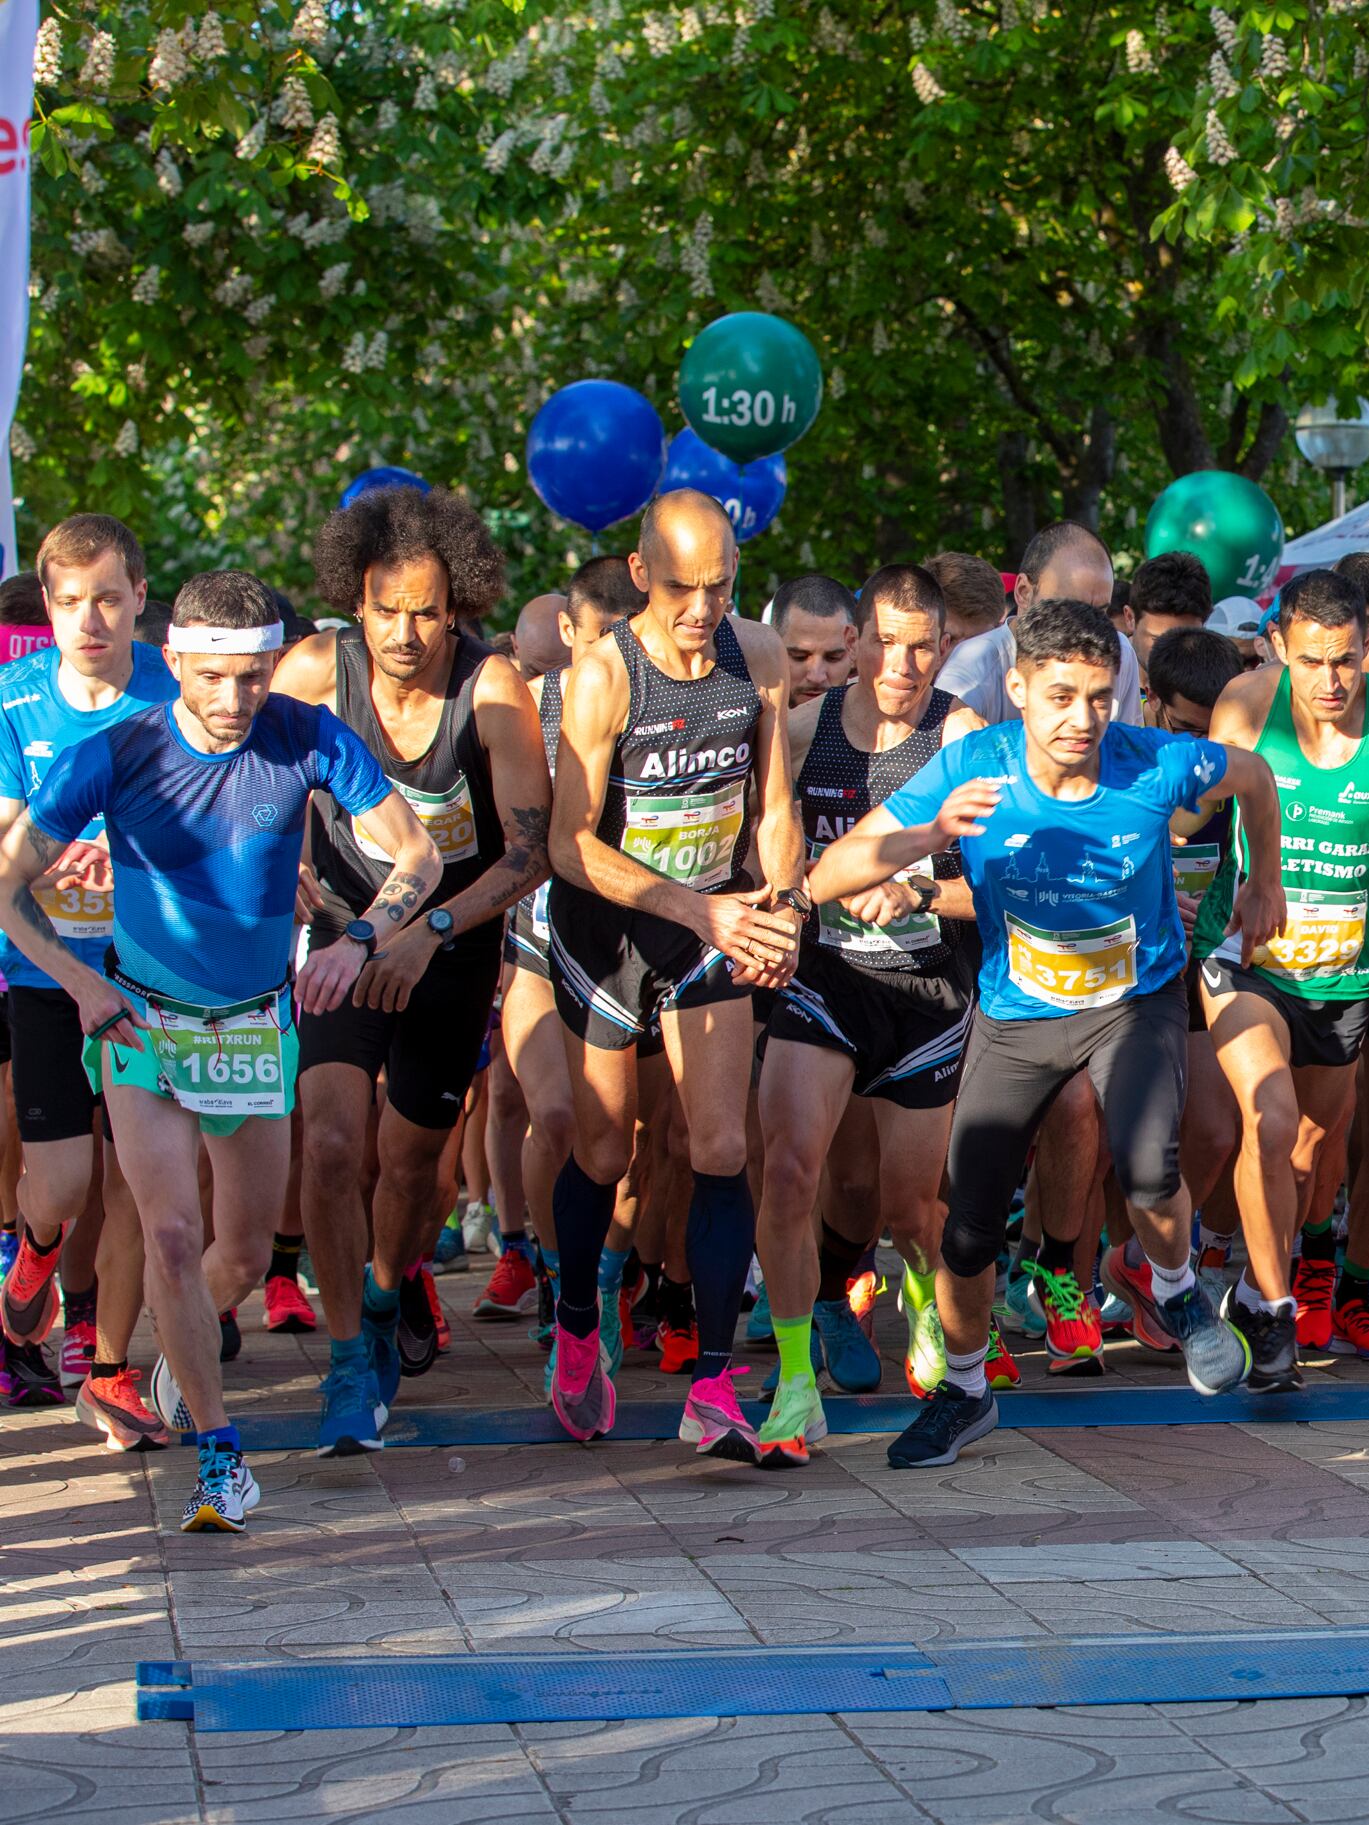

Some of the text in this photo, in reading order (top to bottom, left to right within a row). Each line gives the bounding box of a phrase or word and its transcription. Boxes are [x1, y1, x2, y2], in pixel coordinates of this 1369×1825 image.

[702, 387, 796, 427] 1:30 h
[640, 743, 750, 778] Alimco
[679, 826, 720, 841] BORJA
[653, 834, 735, 873] 1002
[1301, 924, 1338, 934] DAVID
[1274, 938, 1360, 963] 3329
[1036, 959, 1127, 990] 3751
[182, 1052, 279, 1084] 1656
